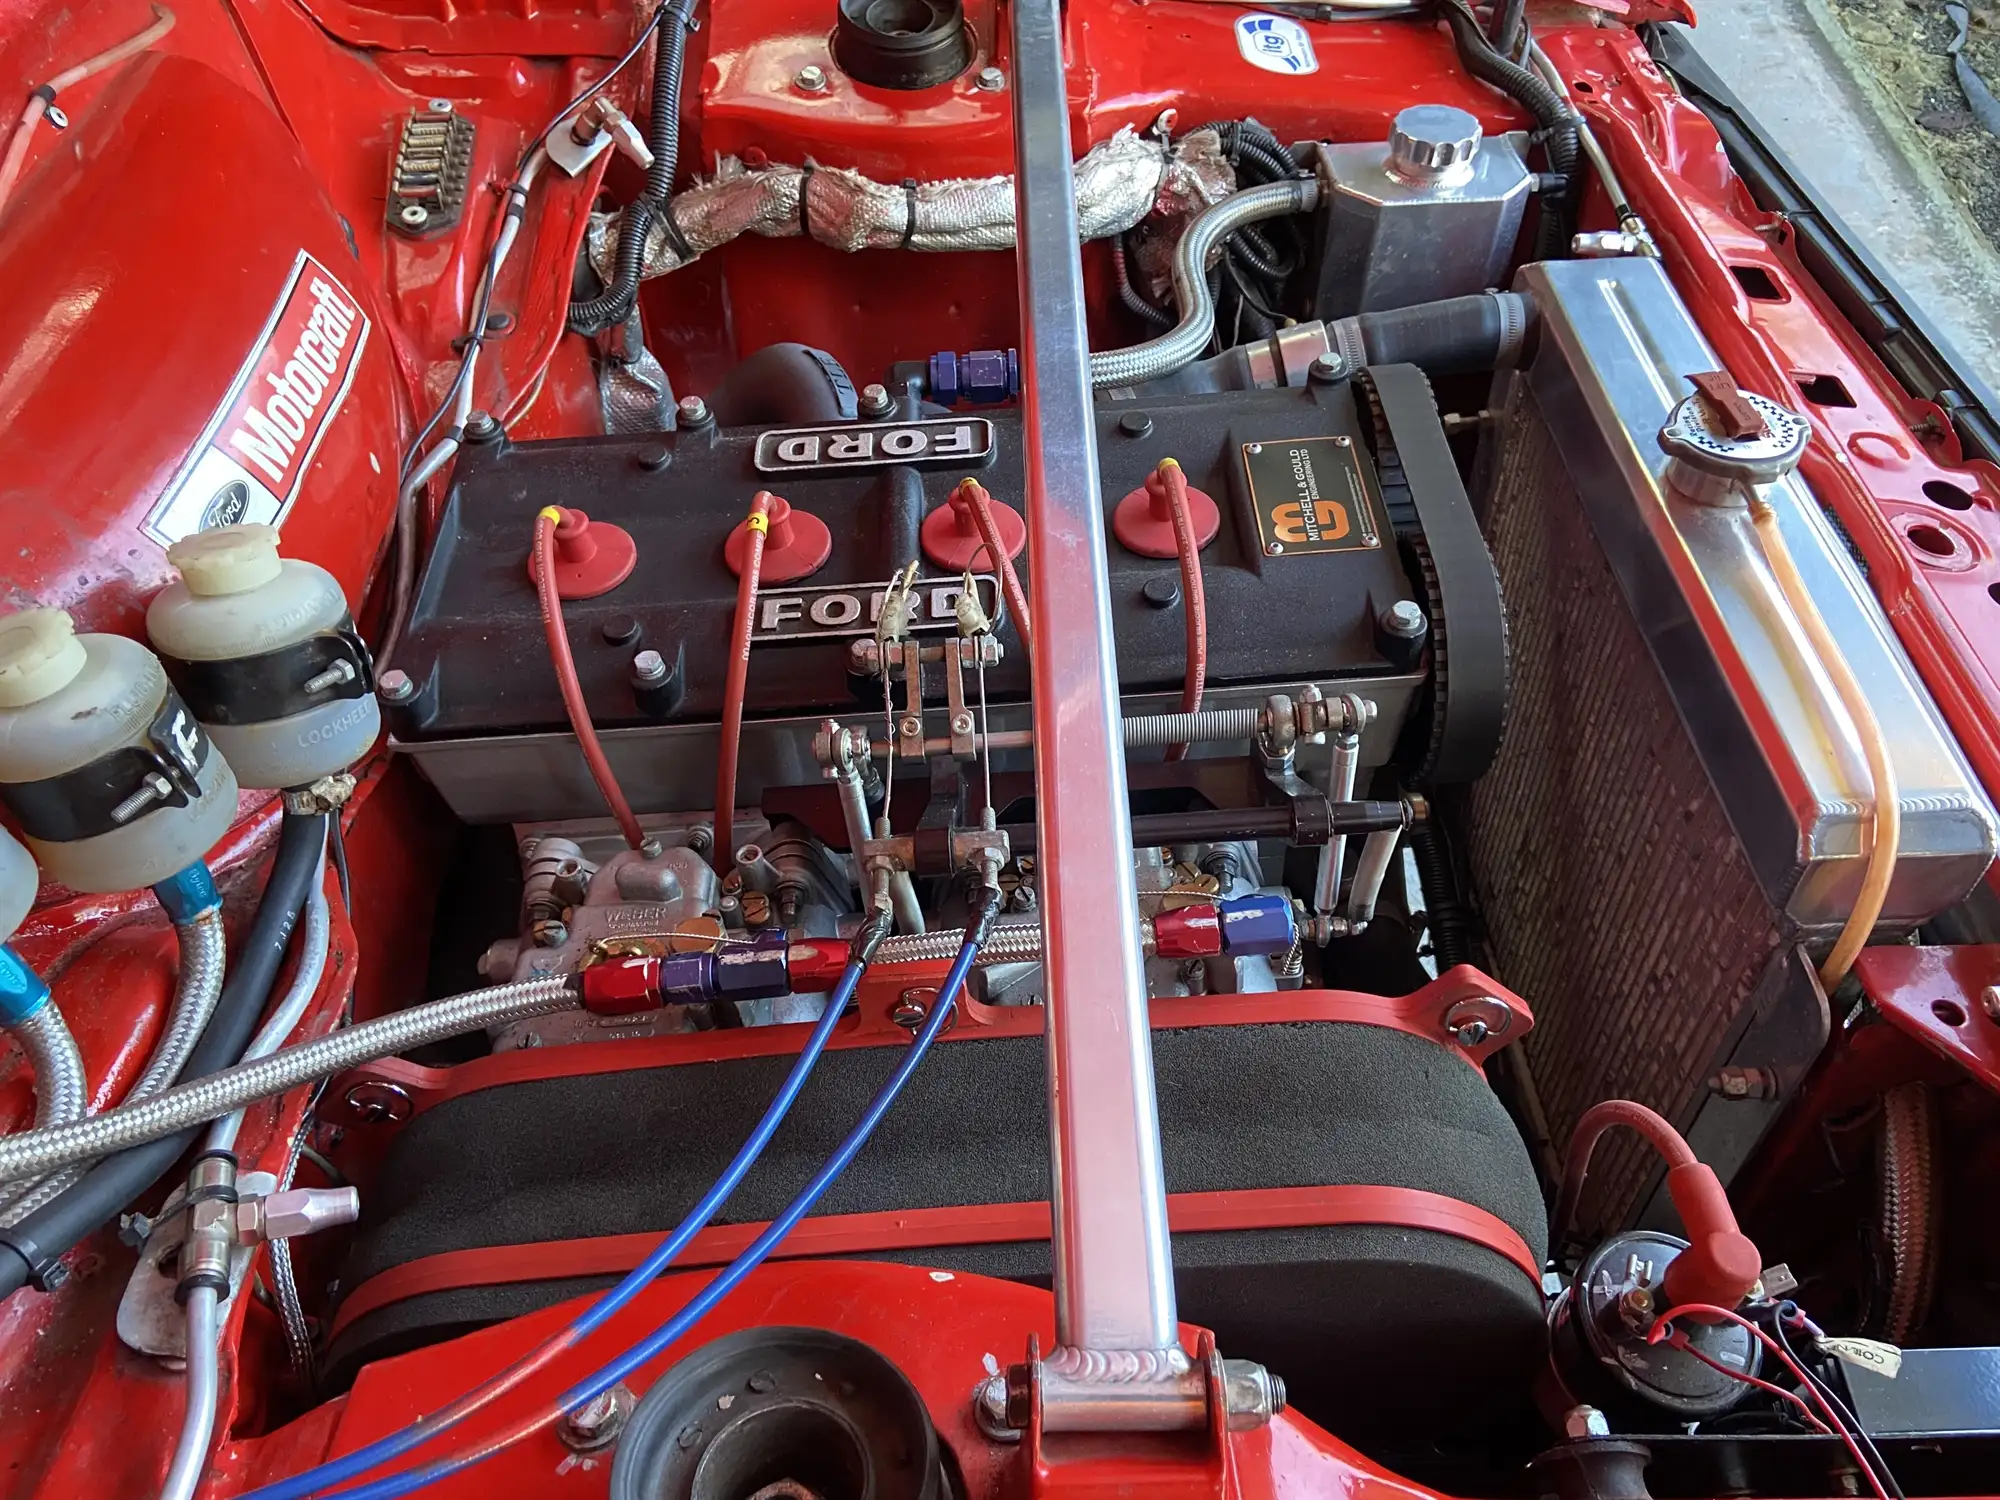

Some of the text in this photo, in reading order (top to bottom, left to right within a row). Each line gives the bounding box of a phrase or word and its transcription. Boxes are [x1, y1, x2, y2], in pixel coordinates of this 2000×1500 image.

[229, 277, 357, 483] Motorcraft
[777, 425, 971, 463] FORD
[1289, 448, 1306, 481] GOULD
[1300, 448, 1320, 500] ENGINEERING LTD
[207, 491, 242, 528] Ford
[1298, 489, 1320, 541] MITCHELL
[741, 594, 758, 661] MAGNECOR
[606, 907, 667, 922] WEBER
